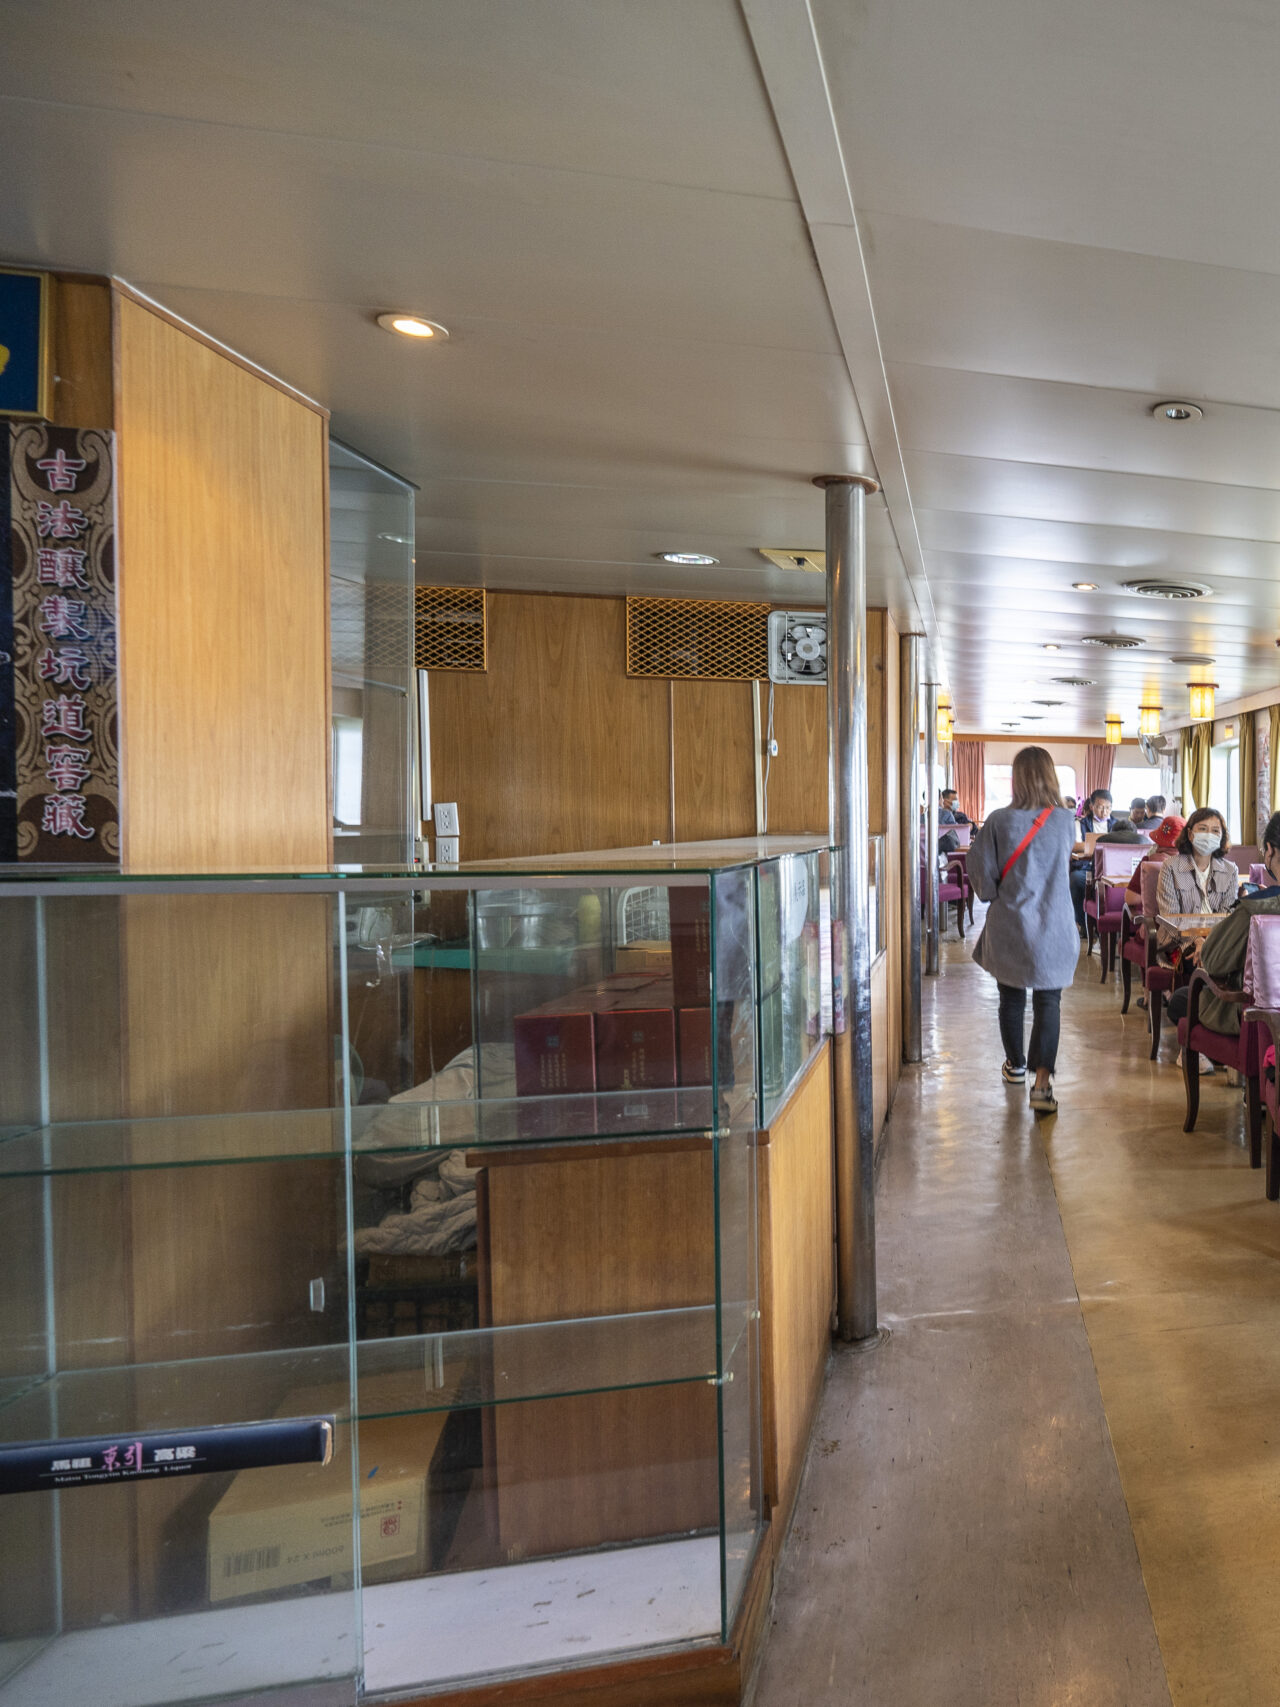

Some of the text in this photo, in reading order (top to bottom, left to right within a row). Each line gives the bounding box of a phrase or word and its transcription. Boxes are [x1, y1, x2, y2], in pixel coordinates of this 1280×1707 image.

[36, 448, 95, 839] 古法釀製坑道窖藏
[51, 1442, 197, 1472] 馬祖 東引 高粱
